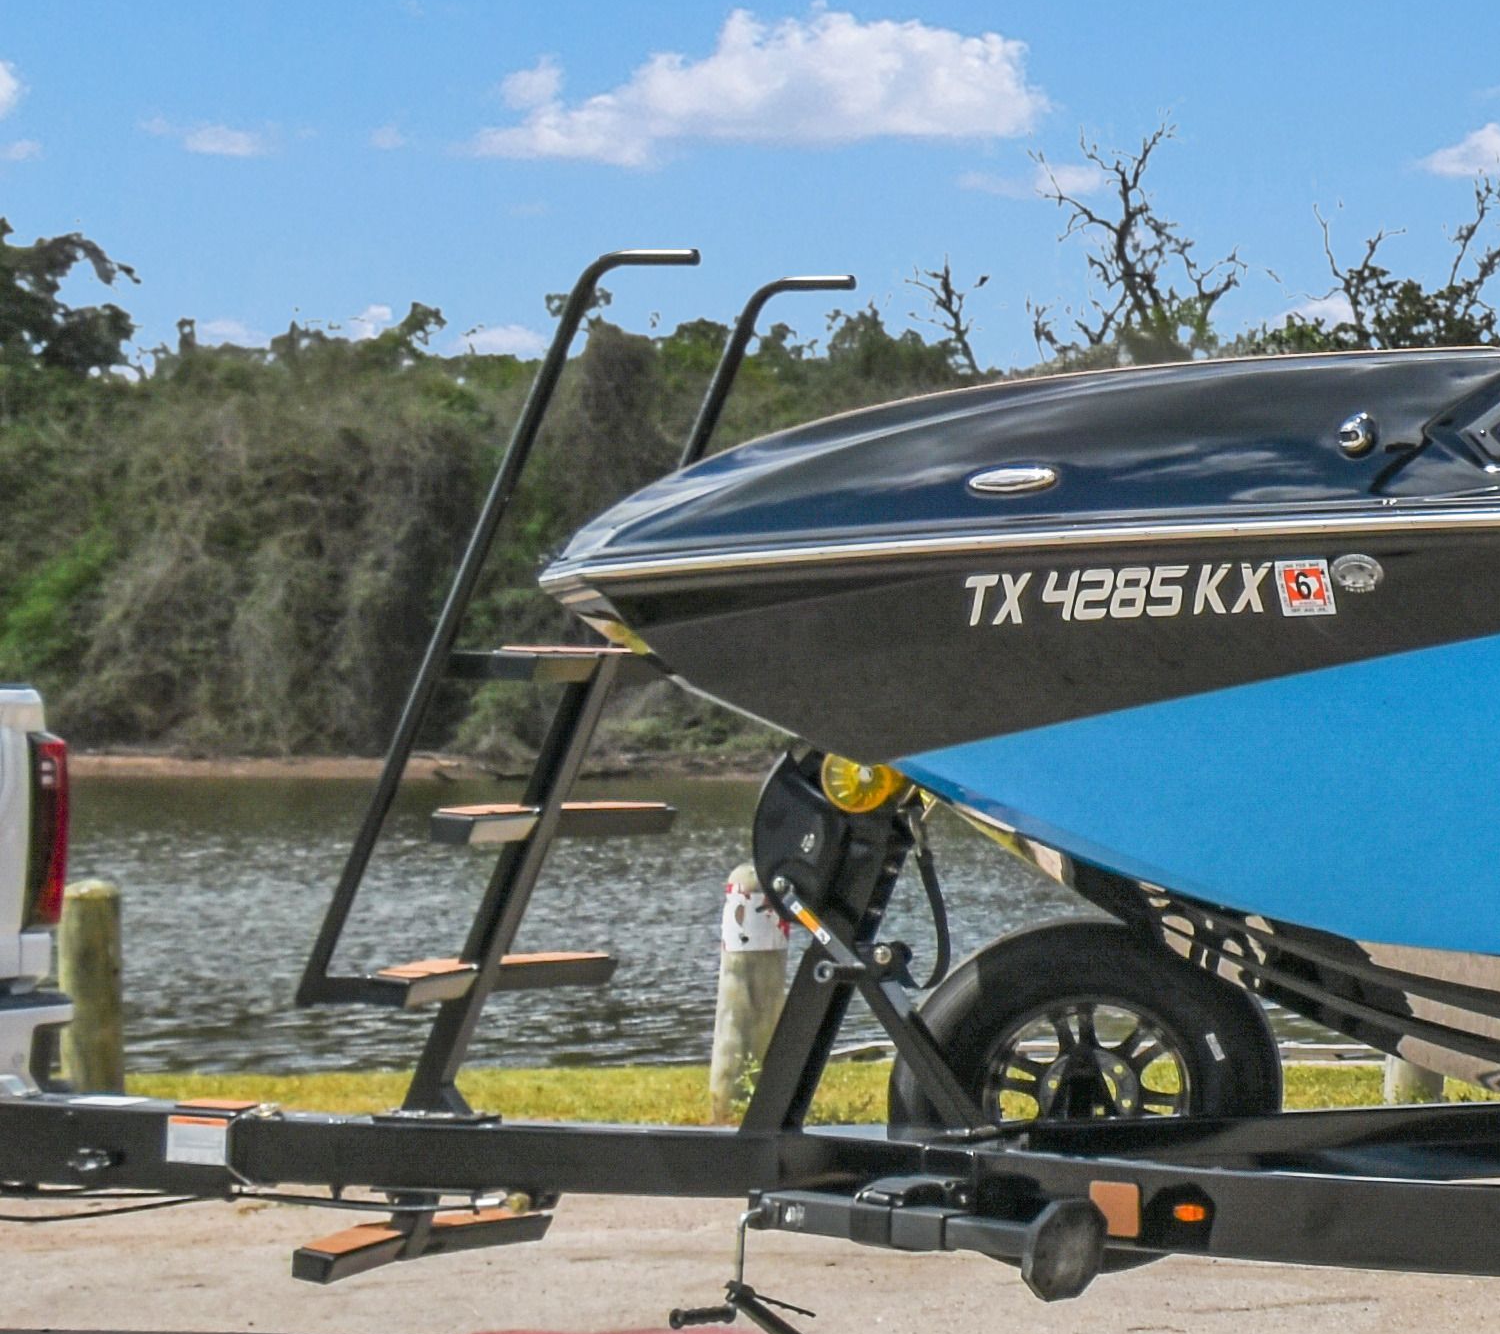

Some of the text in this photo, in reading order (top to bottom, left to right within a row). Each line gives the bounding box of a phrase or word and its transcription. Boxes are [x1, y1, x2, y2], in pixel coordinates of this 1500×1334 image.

[966, 572, 1032, 626] TX
[1042, 566, 1189, 621] 4285
[1193, 563, 1272, 615] KX
[1296, 571, 1312, 599] 6
